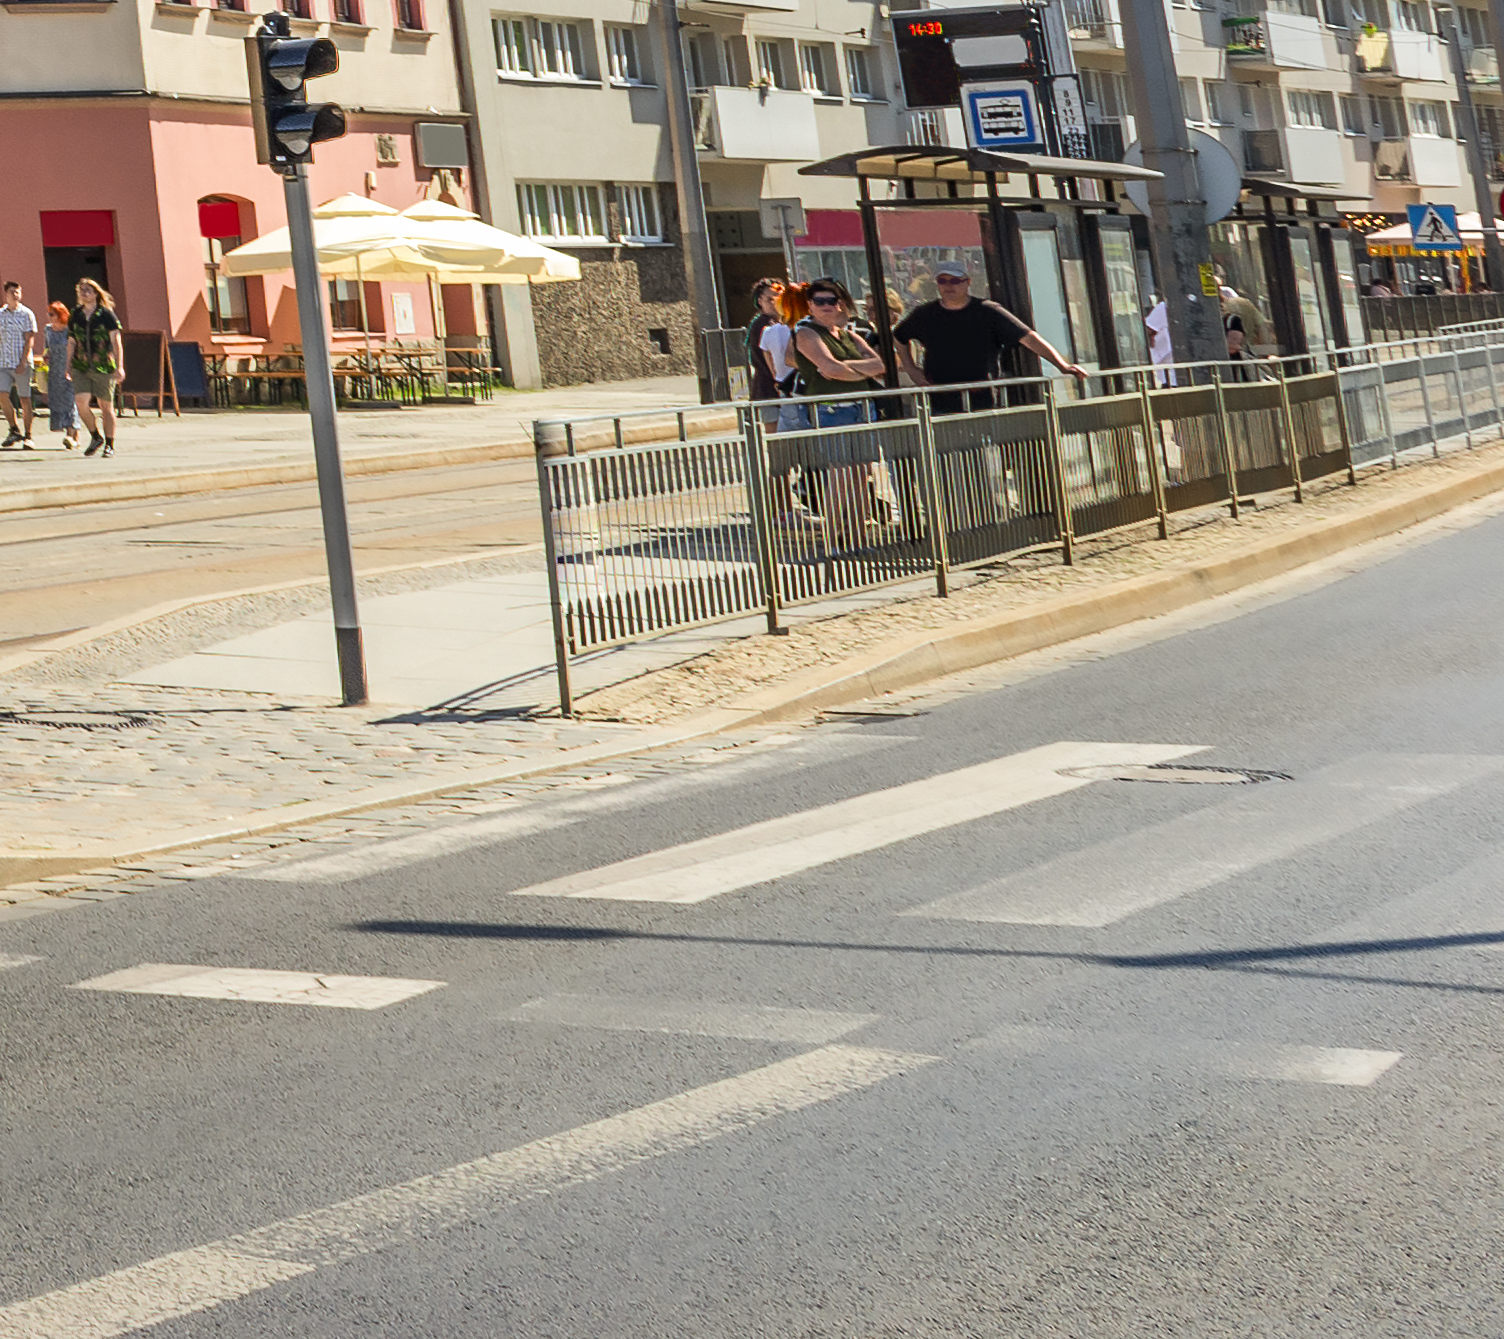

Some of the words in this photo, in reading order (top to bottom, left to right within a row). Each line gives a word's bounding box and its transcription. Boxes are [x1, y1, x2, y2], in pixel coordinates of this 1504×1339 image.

[908, 21, 943, 36] 14:30
[1063, 90, 1069, 98] 8
[1065, 98, 1071, 107] 9
[1063, 108, 1075, 116] 11
[1065, 116, 1076, 125] 17
